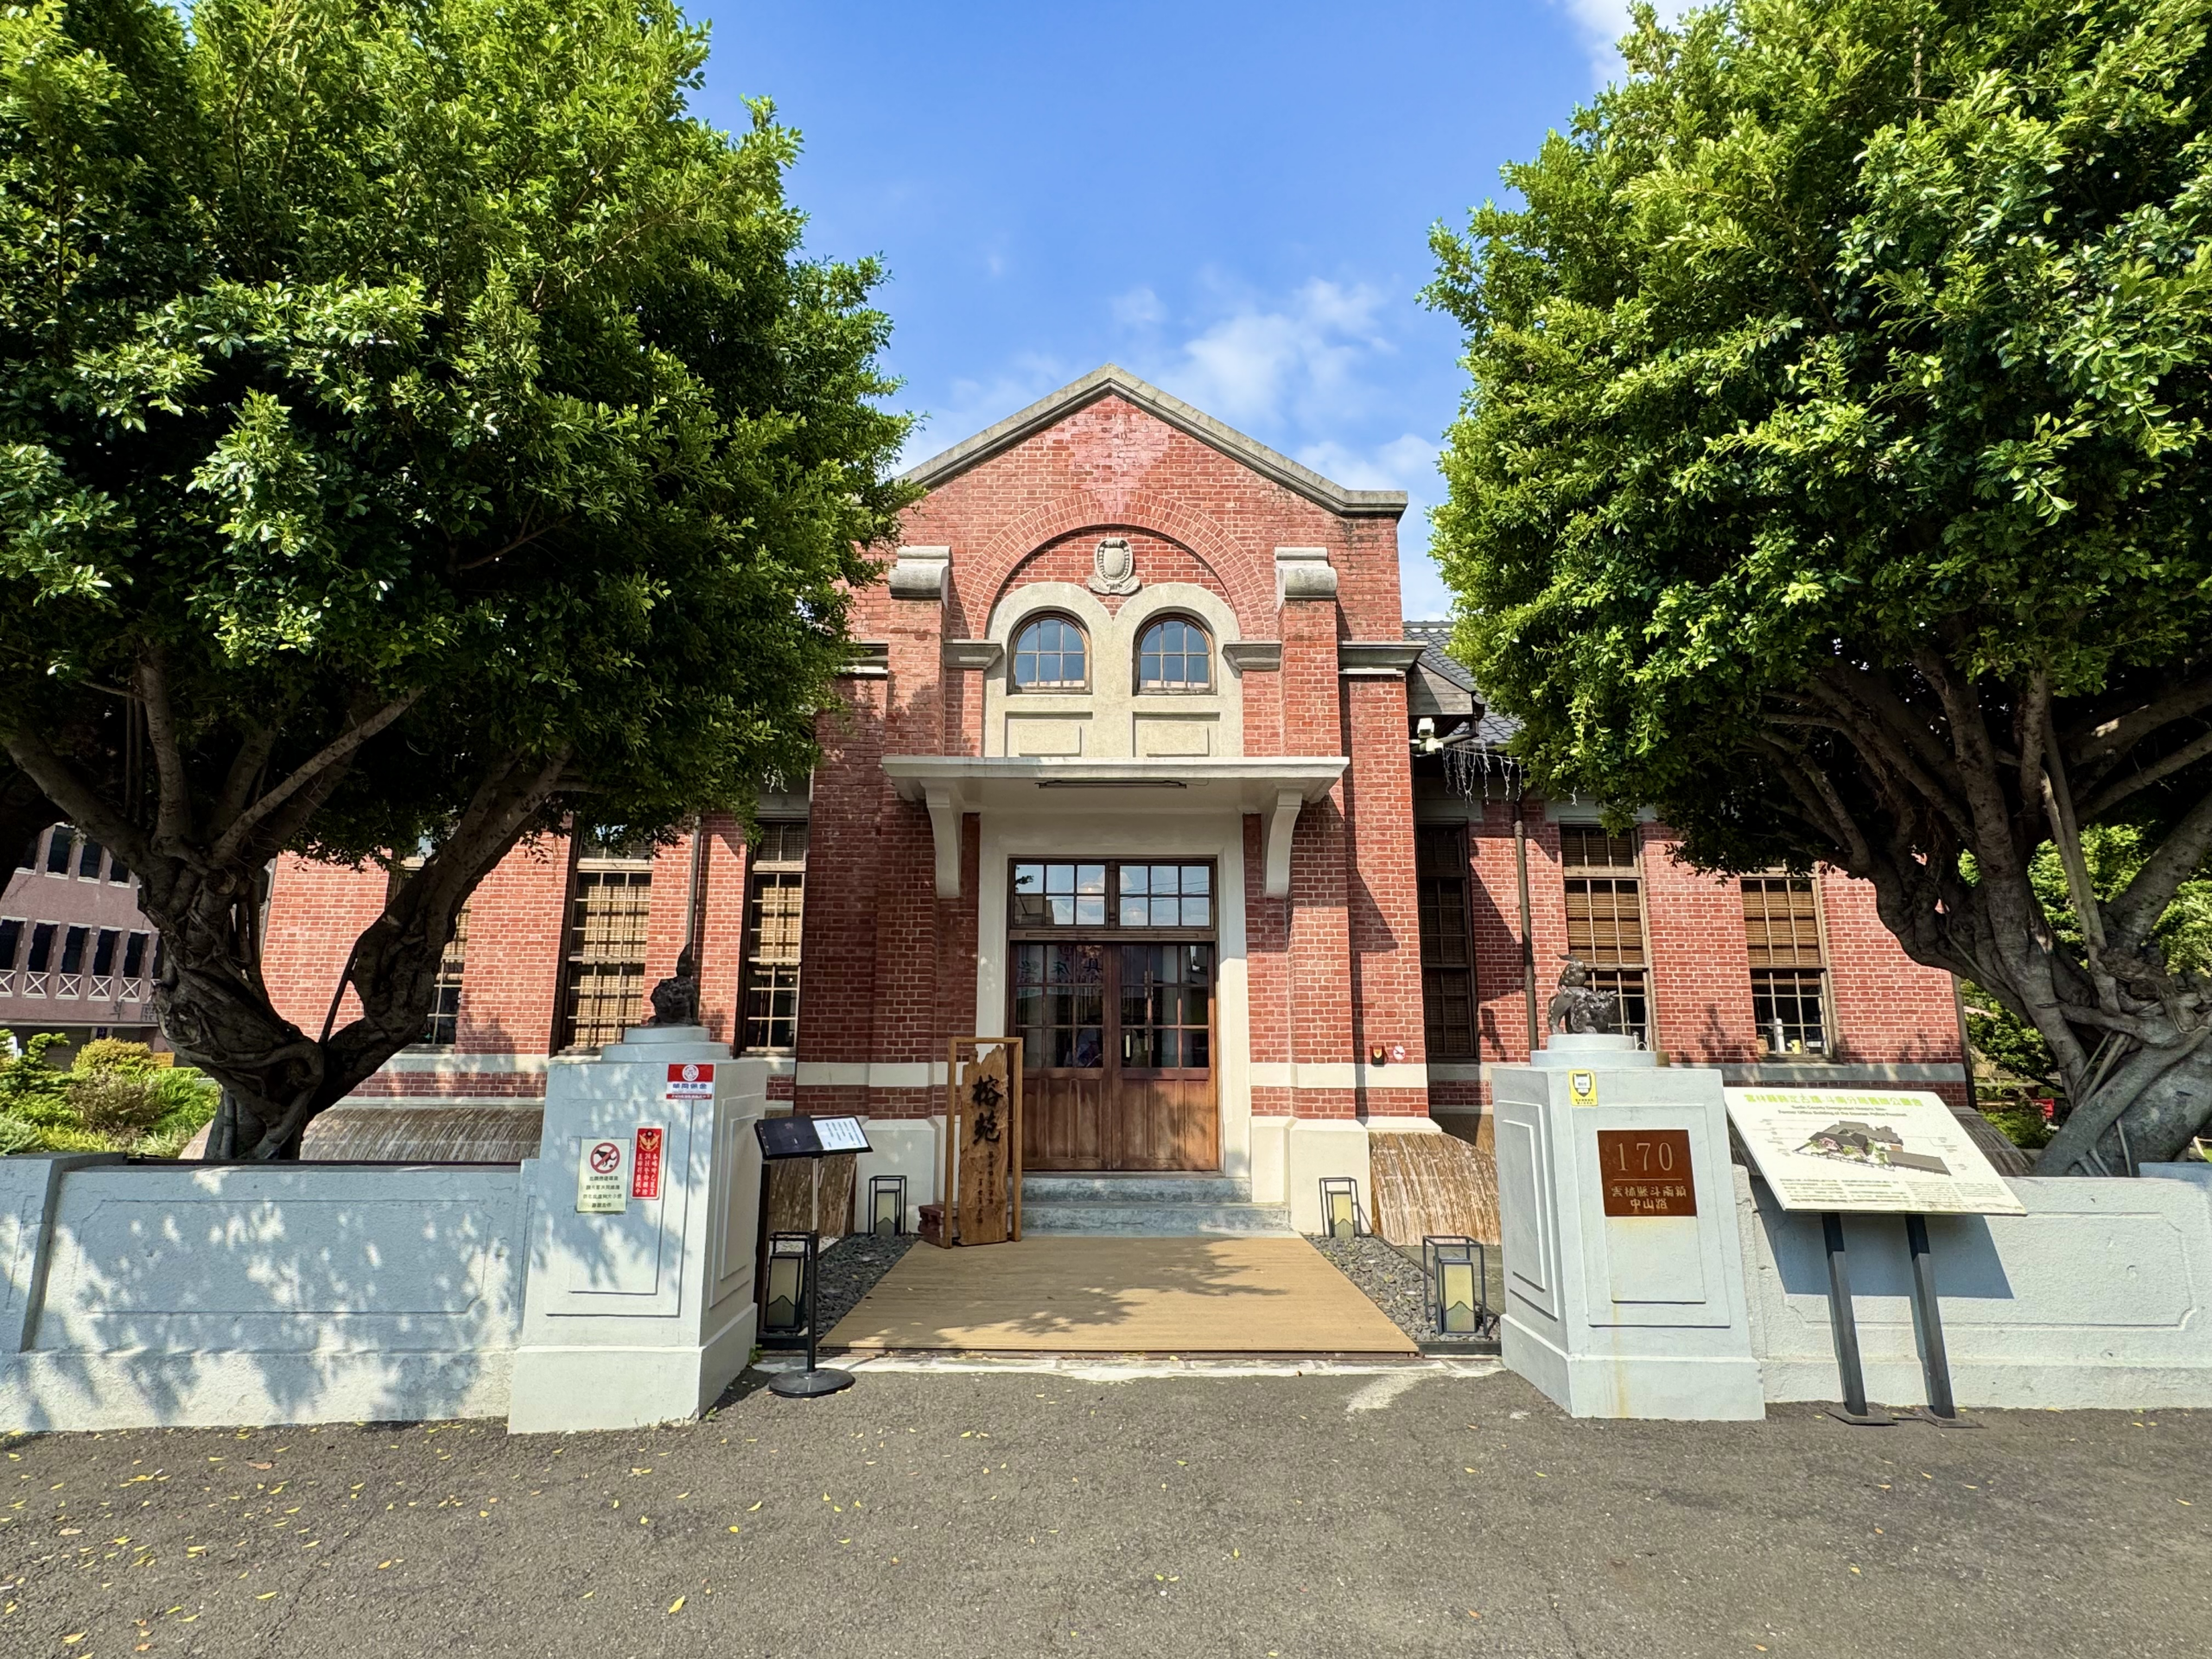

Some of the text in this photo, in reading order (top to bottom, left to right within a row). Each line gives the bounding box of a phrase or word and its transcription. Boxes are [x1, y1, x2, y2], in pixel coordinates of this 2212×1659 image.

[972, 1075, 1003, 1145] 榕苑
[1617, 1142, 1673, 1172] 170
[1611, 1185, 1688, 1198] 雲林縣斗南鎮
[1630, 1198, 1668, 1210] 中山路
